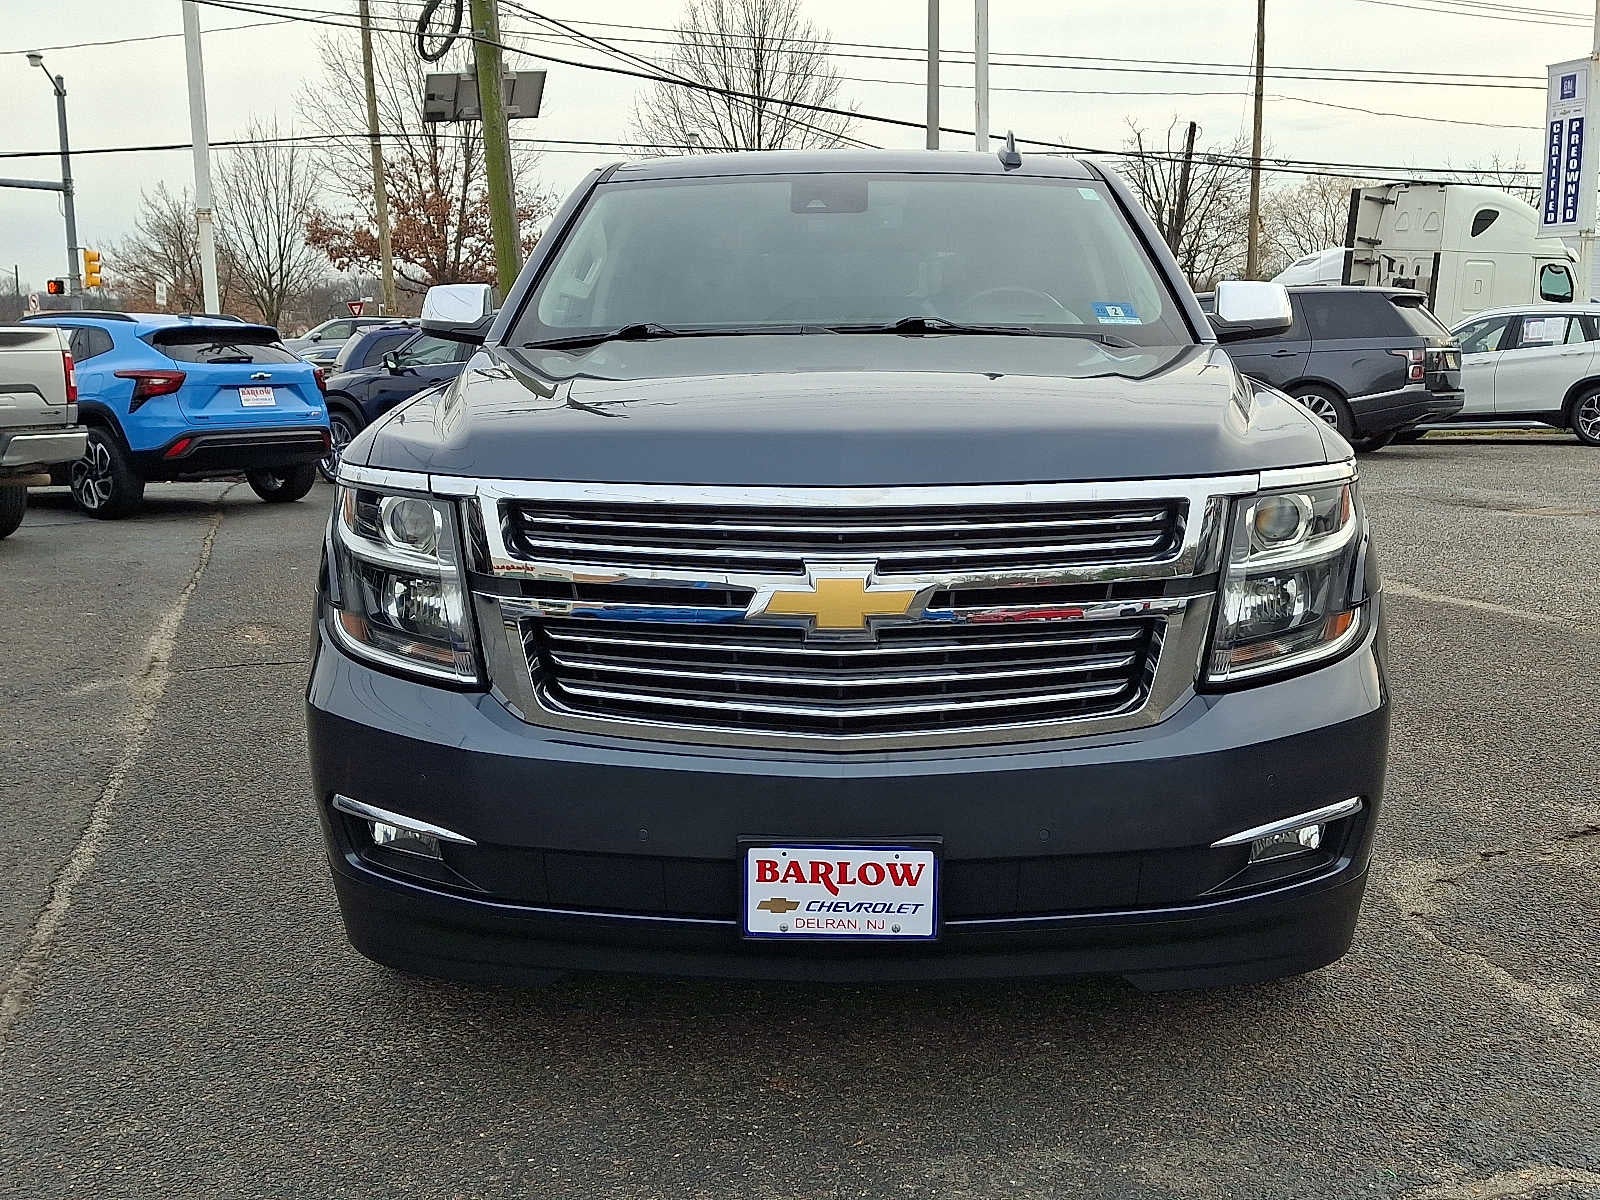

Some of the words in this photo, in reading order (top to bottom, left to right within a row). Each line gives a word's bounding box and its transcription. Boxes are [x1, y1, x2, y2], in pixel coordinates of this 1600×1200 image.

[1547, 123, 1561, 222] CERTIFIED
[1565, 120, 1580, 220] PREOWNED
[1111, 307, 1120, 315] 2
[241, 389, 271, 397] BARLOW
[755, 859, 926, 897] BARLOW
[805, 900, 925, 915] CHEVROLET
[795, 917, 861, 931] DELRAN,
[866, 919, 886, 930] NJ
